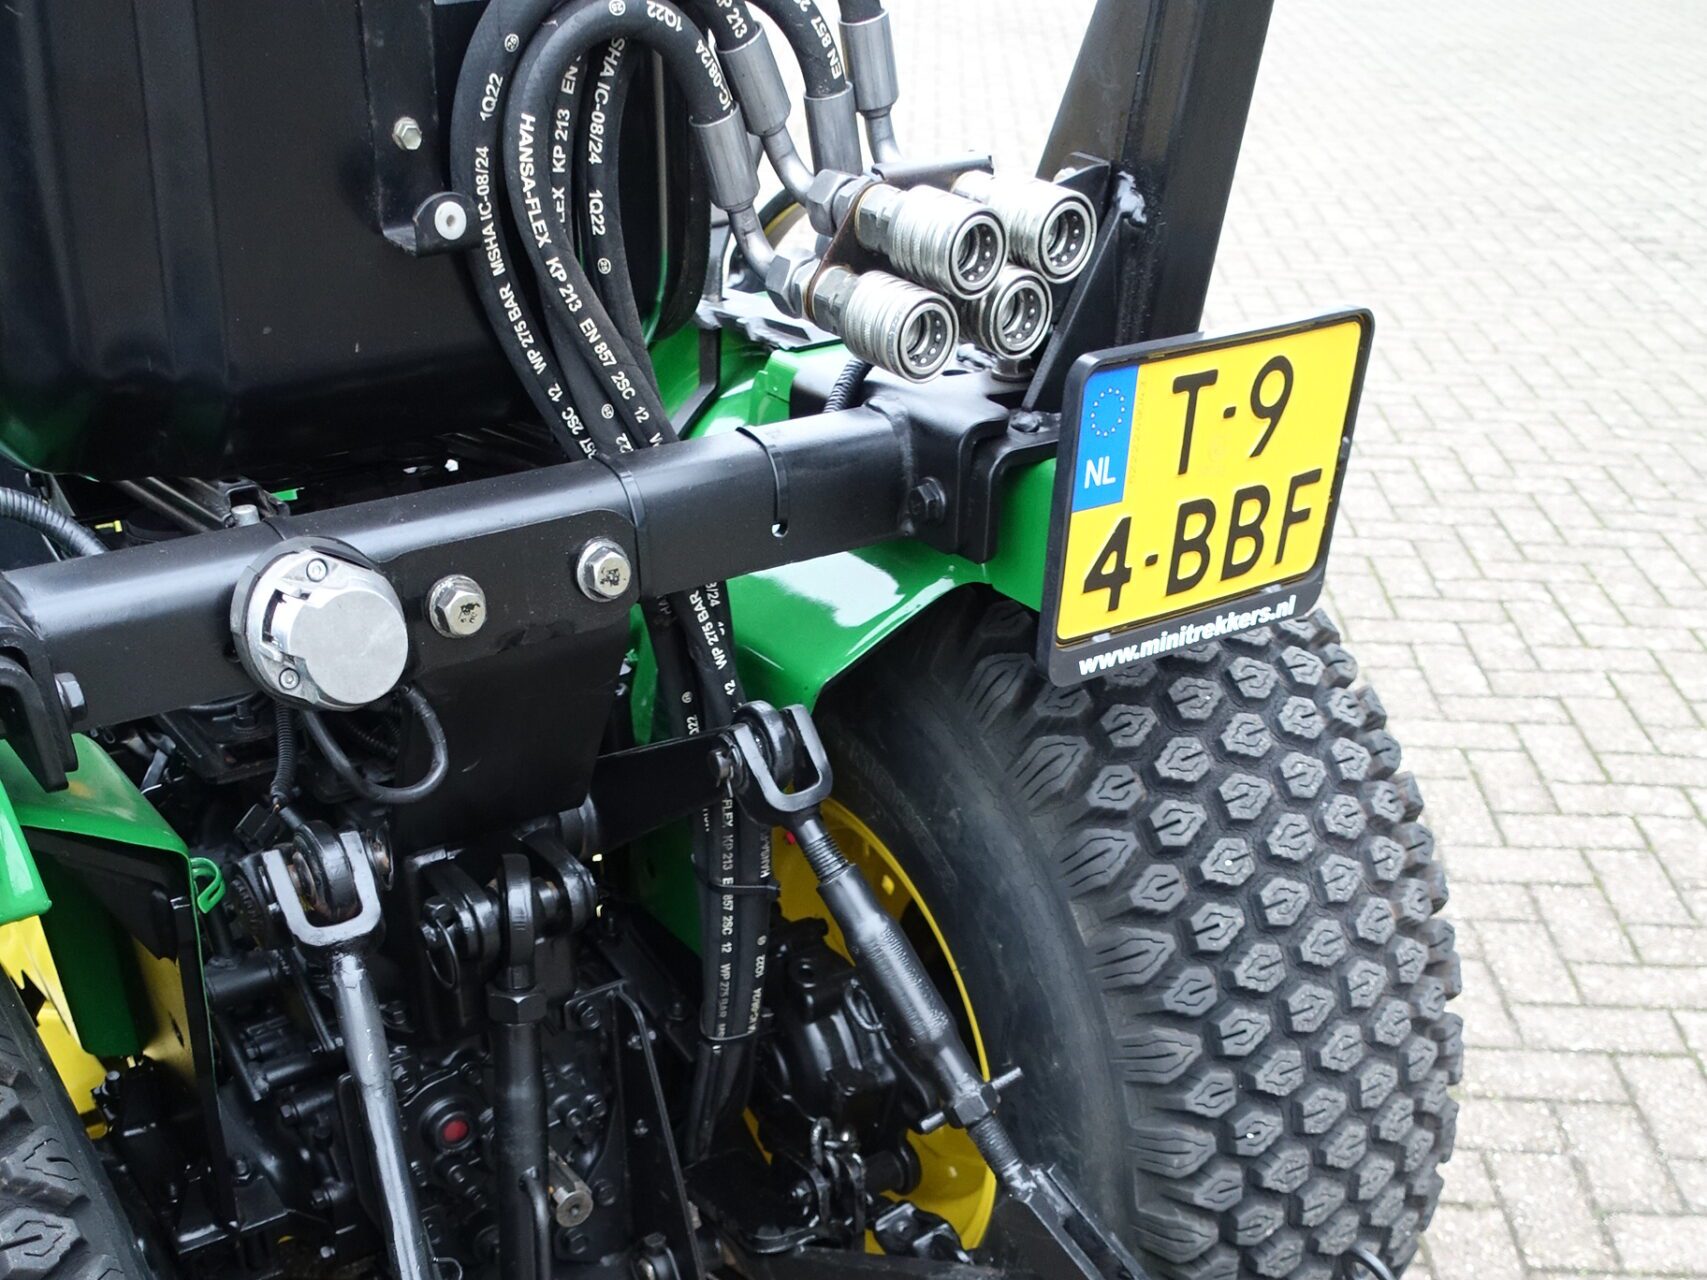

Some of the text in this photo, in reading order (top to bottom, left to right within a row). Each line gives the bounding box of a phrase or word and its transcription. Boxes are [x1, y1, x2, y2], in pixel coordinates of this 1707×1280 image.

[646, 0, 683, 33] 1Q22
[726, 8, 748, 39] 213
[600, 37, 626, 78] SHA
[811, 16, 843, 80] EN 857
[561, 65, 579, 95] EN
[695, 39, 732, 111] IC-08/24
[480, 72, 503, 121] 1Q22
[555, 108, 571, 142] 213
[588, 81, 611, 165] IC-08/24
[552, 145, 566, 173] KP
[475, 146, 492, 222] IC-08/24
[588, 189, 606, 236] 1Q22
[482, 222, 506, 276] MSHA
[518, 112, 650, 424] HANSA-FLEX KP 213 EN 857 2SC 12
[499, 282, 523, 323] BAR
[514, 320, 535, 348] 275
[526, 350, 548, 375] WP
[548, 383, 564, 402] 12
[561, 406, 585, 435] 2SC
[1172, 355, 1294, 476] T-9
[1083, 455, 1117, 489] NL
[1082, 468, 1323, 612] 4-BBF
[689, 590, 710, 623] BAR
[701, 621, 720, 647] 275
[1079, 594, 1297, 676] www.minitrekkers.nl
[711, 646, 728, 670] WP
[724, 679, 736, 696] 12
[722, 834, 734, 851] KP
[722, 853, 734, 871] 213
[722, 877, 734, 886] E
[722, 894, 734, 911] 857
[722, 915, 734, 936] 2SC
[721, 941, 733, 953] 12
[719, 963, 731, 980] WP
